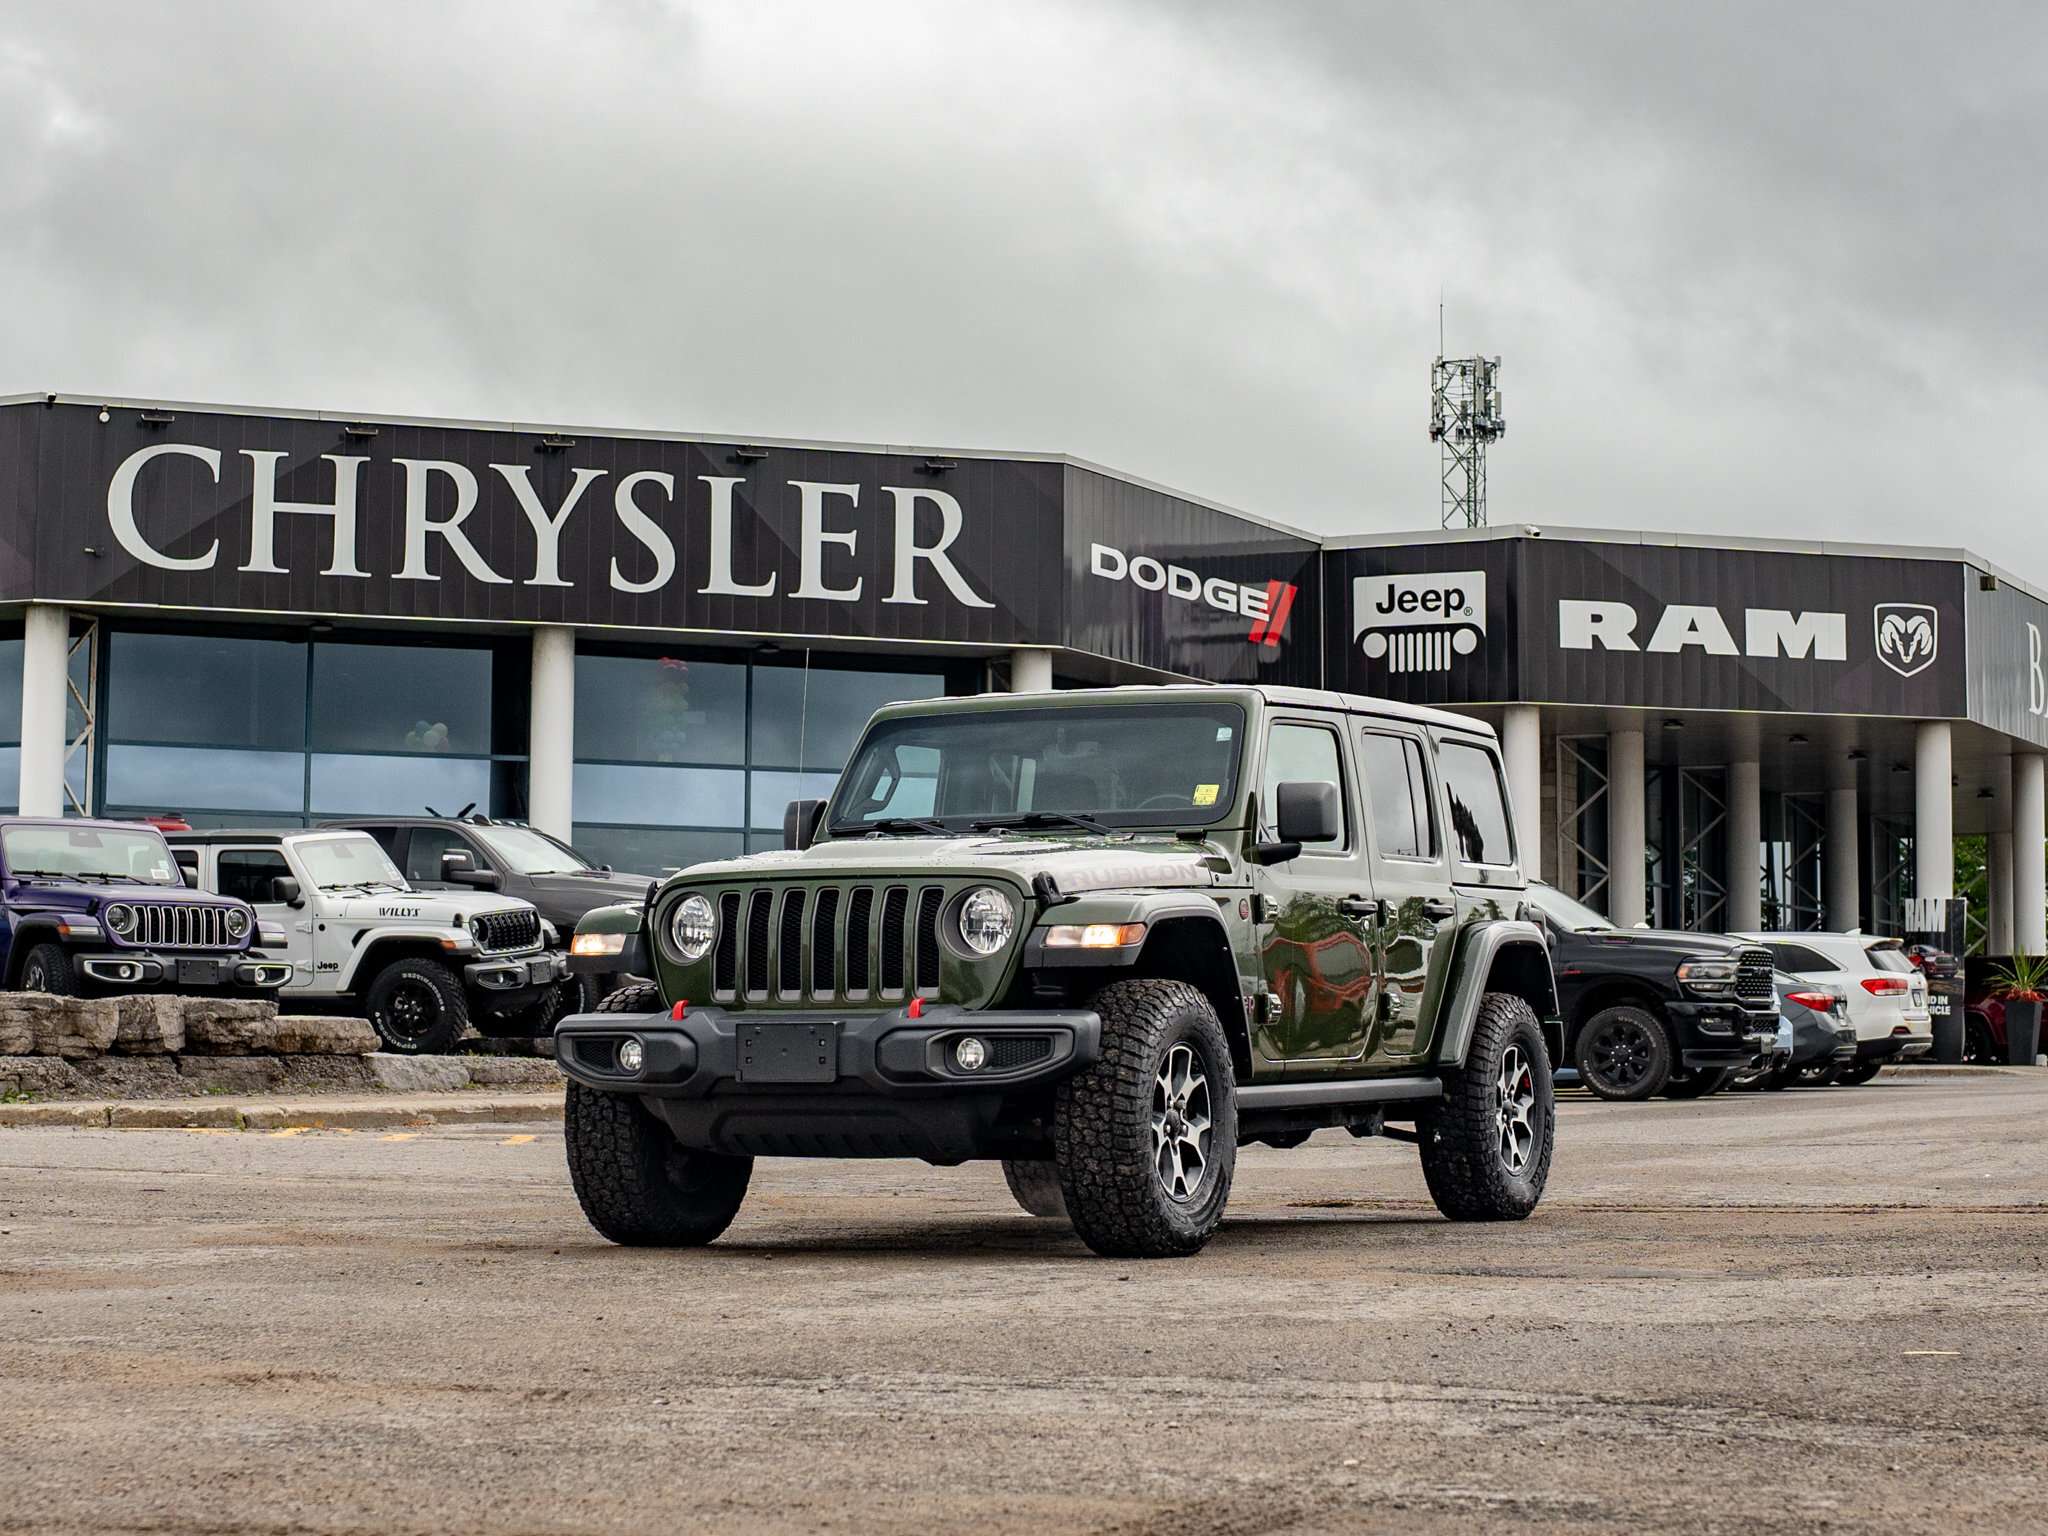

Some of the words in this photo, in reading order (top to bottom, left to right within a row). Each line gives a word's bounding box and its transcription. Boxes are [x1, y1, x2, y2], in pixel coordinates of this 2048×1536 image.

[107, 443, 997, 609] CHRYSLER
[1091, 542, 1270, 622] DODGE
[1375, 583, 1466, 618] Jeep
[1558, 600, 1847, 660] RAM
[2025, 621, 2048, 719] B
[1069, 863, 1199, 889] RUBICON
[379, 907, 421, 917] WILLYS
[1905, 897, 1945, 932] RAM
[317, 961, 339, 970] Jeep
[1938, 995, 1948, 1005] IN
